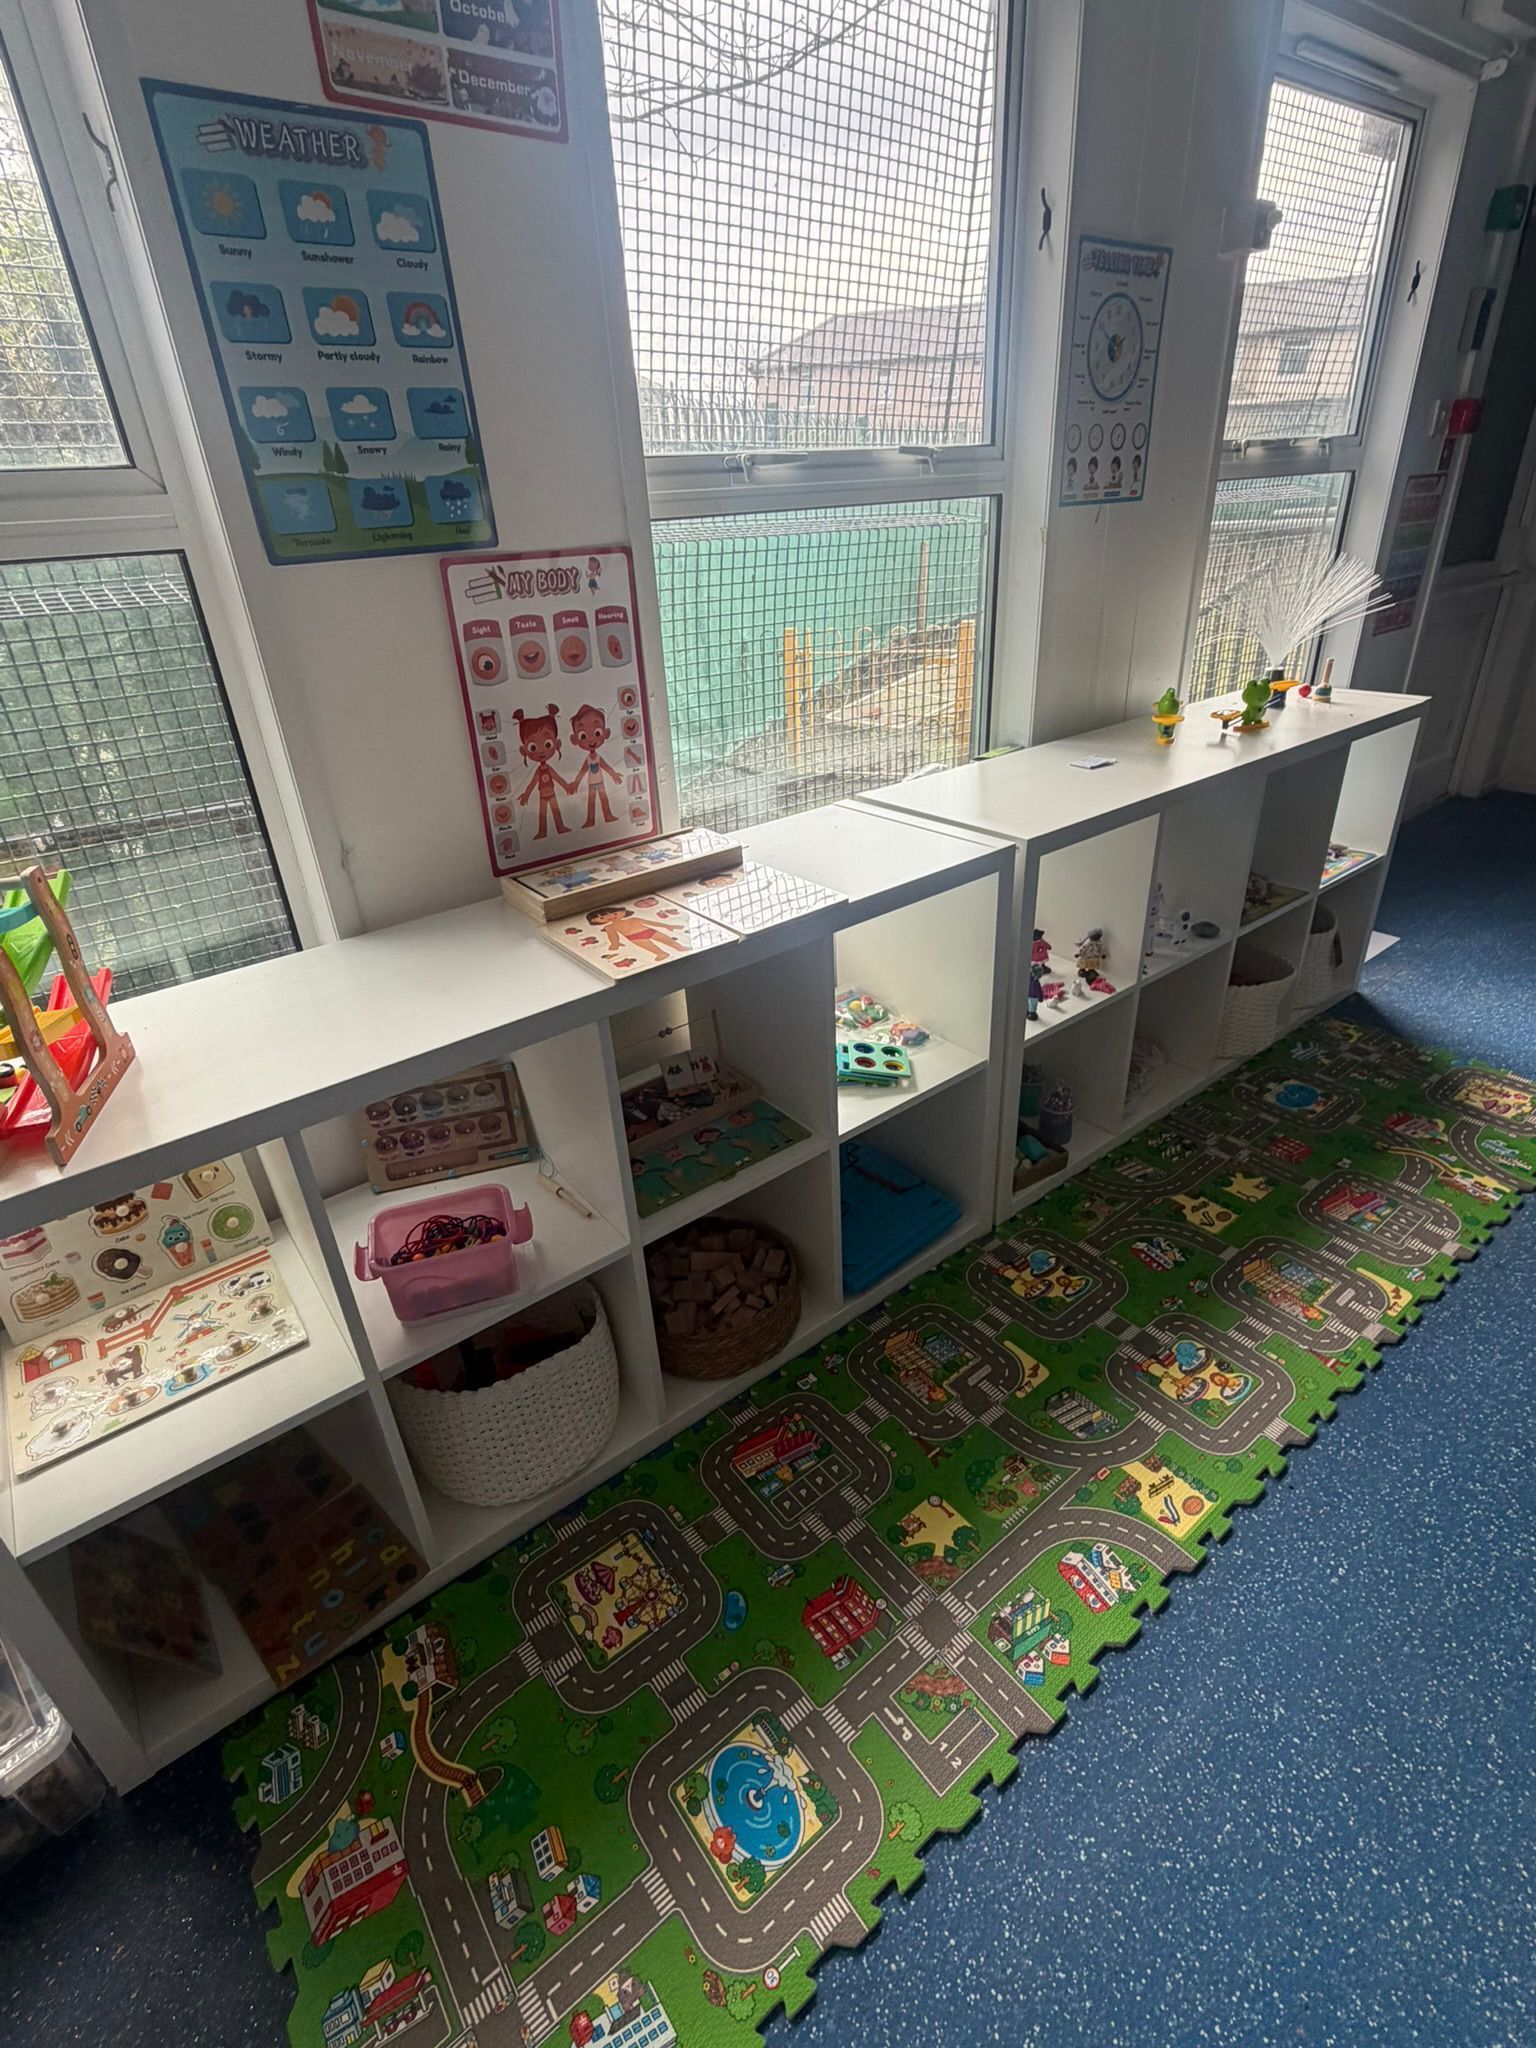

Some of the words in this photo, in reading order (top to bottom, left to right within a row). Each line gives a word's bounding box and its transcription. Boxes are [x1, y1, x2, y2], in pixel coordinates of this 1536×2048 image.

[458, 68, 531, 97] December
[233, 118, 362, 163] WEATHER
[218, 244, 252, 259] Sunny
[302, 251, 355, 265] Sunshower
[396, 258, 429, 271] Cloudy
[246, 350, 283, 363] Stormy
[318, 350, 348, 363] Partly
[350, 350, 381, 364] cloudy
[412, 353, 449, 365] Rainbow
[272, 446, 303, 459] Windy
[357, 444, 387, 456] Snowy
[507, 571, 534, 597] MY
[536, 567, 580, 596] BODY
[515, 620, 537, 630] Taste
[562, 615, 580, 625] Smell
[471, 625, 492, 636] Sight
[831, 1465, 839, 1473] P
[816, 1476, 823, 1485] P
[800, 1488, 807, 1497] P
[783, 1500, 791, 1510] P
[939, 1741, 948, 1753] 1
[950, 1756, 962, 1770] 2
